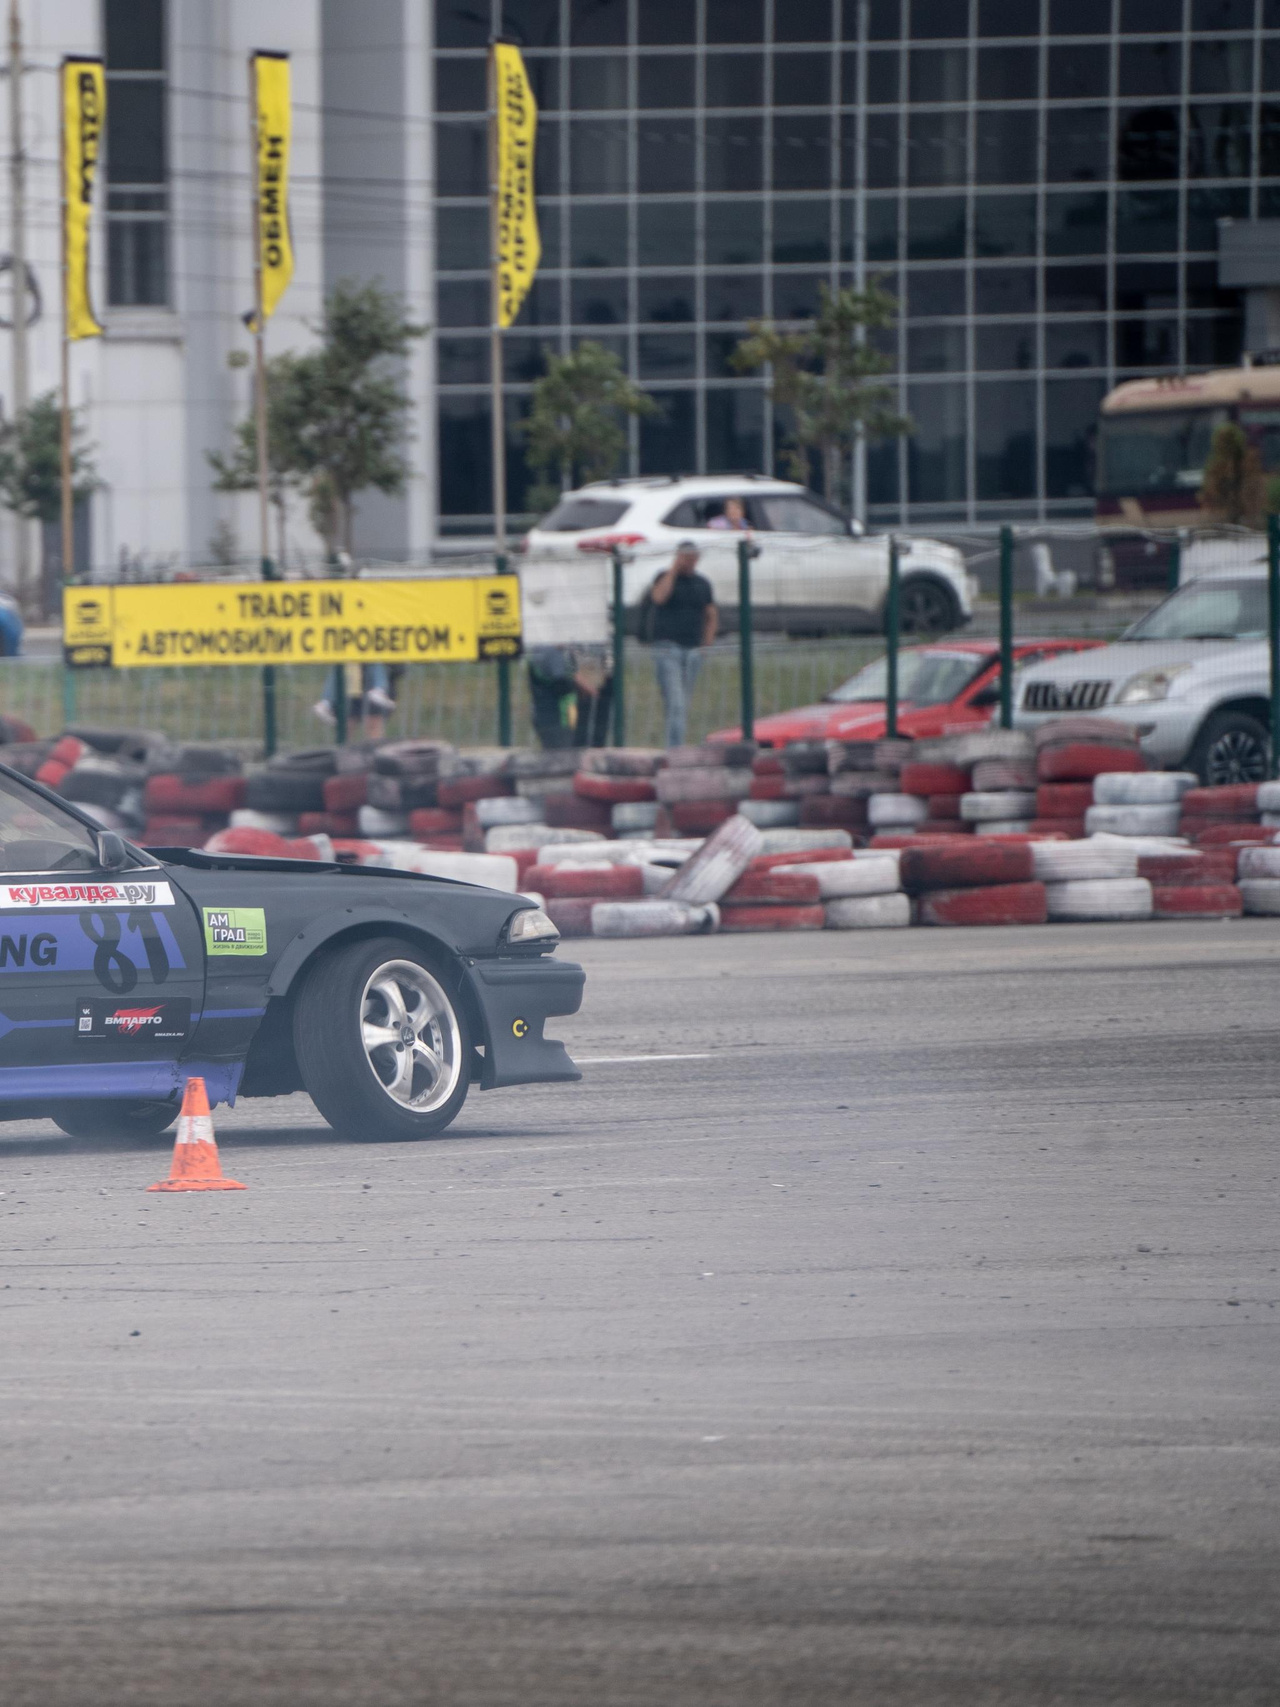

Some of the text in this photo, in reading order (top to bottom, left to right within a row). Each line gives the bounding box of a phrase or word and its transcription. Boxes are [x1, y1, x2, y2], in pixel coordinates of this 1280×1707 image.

[237, 592, 343, 619] TRADE IN
[136, 627, 292, 656] АВТОМОБИЛИ
[300, 629, 315, 653] С
[324, 625, 450, 652] ПРОБЕГОМ
[8, 884, 156, 906] кувалда.ру
[209, 914, 228, 926] АМ
[214, 929, 245, 941] ГРАД
[79, 908, 169, 995] 81
[104, 1016, 163, 1025] ВМПАВТО
